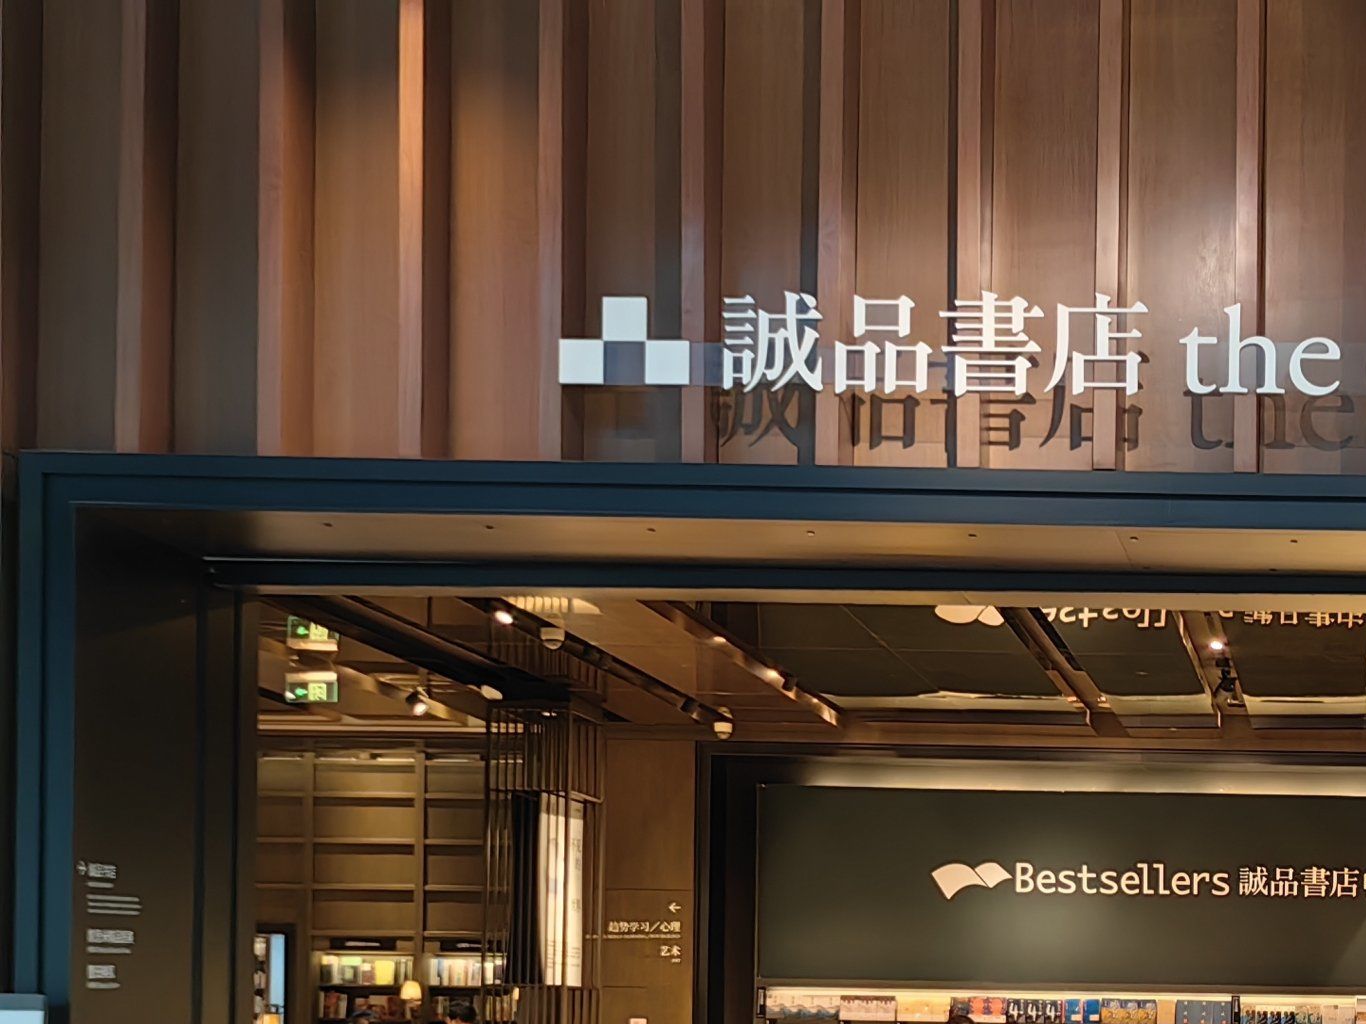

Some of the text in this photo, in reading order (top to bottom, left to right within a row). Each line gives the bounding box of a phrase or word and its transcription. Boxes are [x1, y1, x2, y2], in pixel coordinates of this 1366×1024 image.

[720, 290, 1149, 397] 誠品書店
[1179, 302, 1342, 396] the
[1015, 862, 1231, 897] Bestsellers
